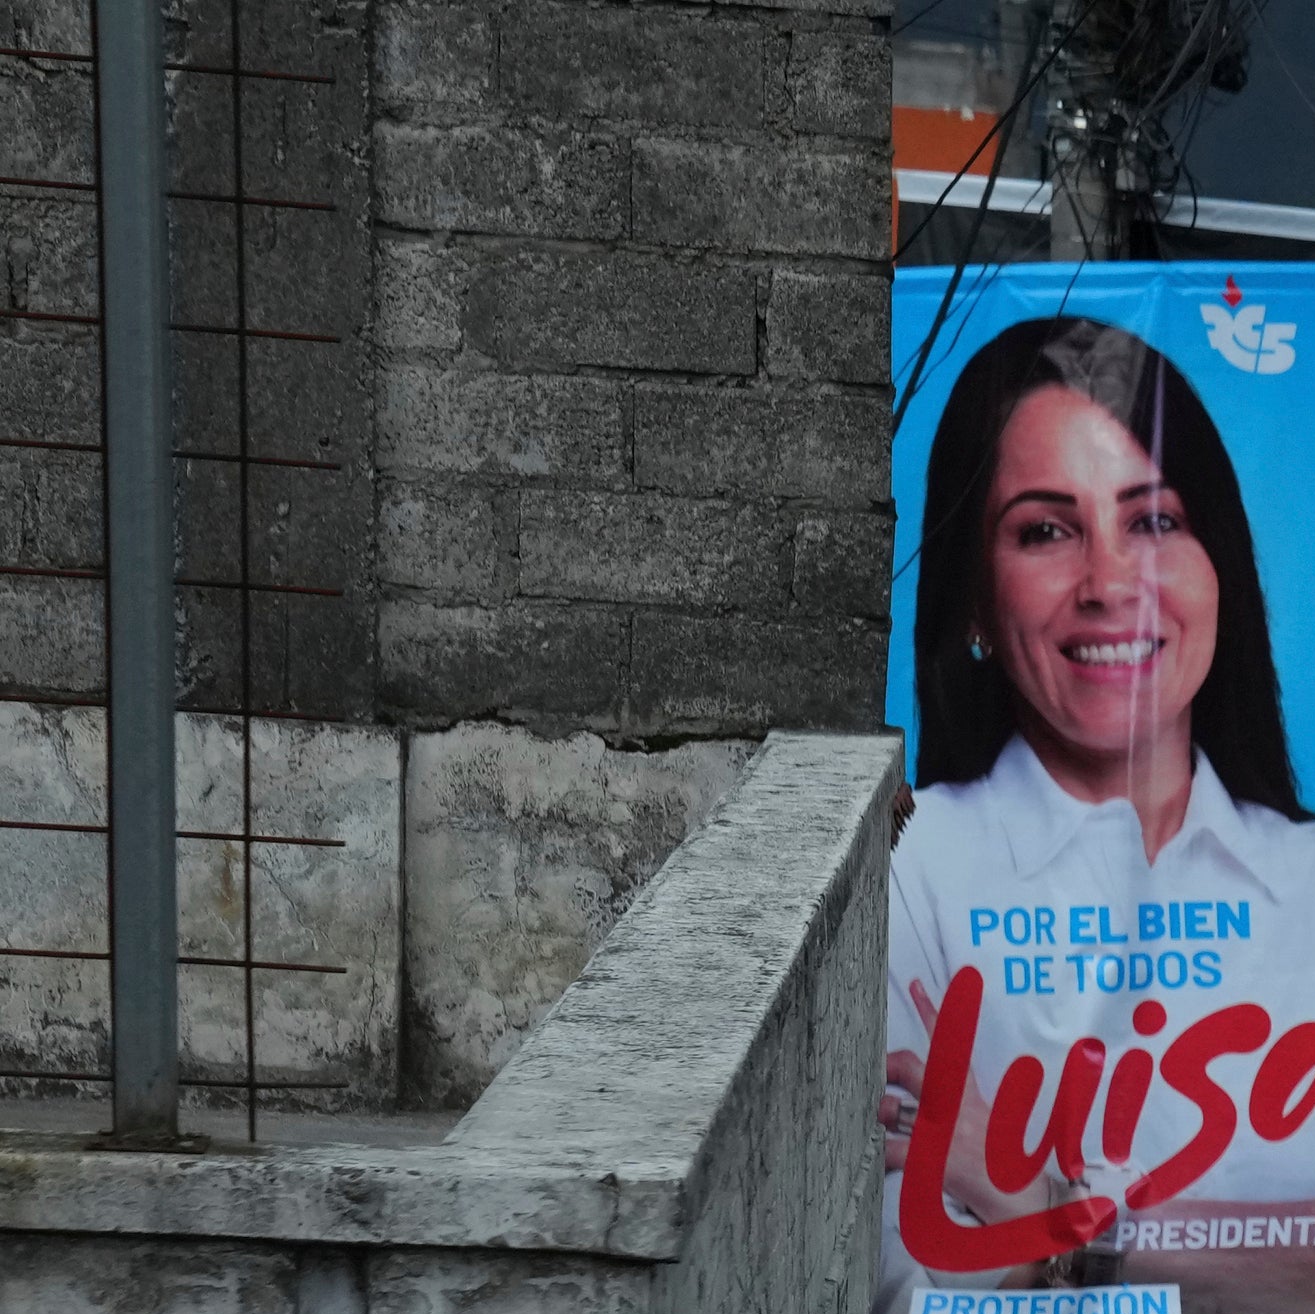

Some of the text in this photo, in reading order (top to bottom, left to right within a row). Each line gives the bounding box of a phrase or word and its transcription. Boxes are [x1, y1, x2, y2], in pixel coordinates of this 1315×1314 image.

[969, 901, 1251, 946] POR EL BIEN
[1003, 950, 1223, 995] DE TODOS
